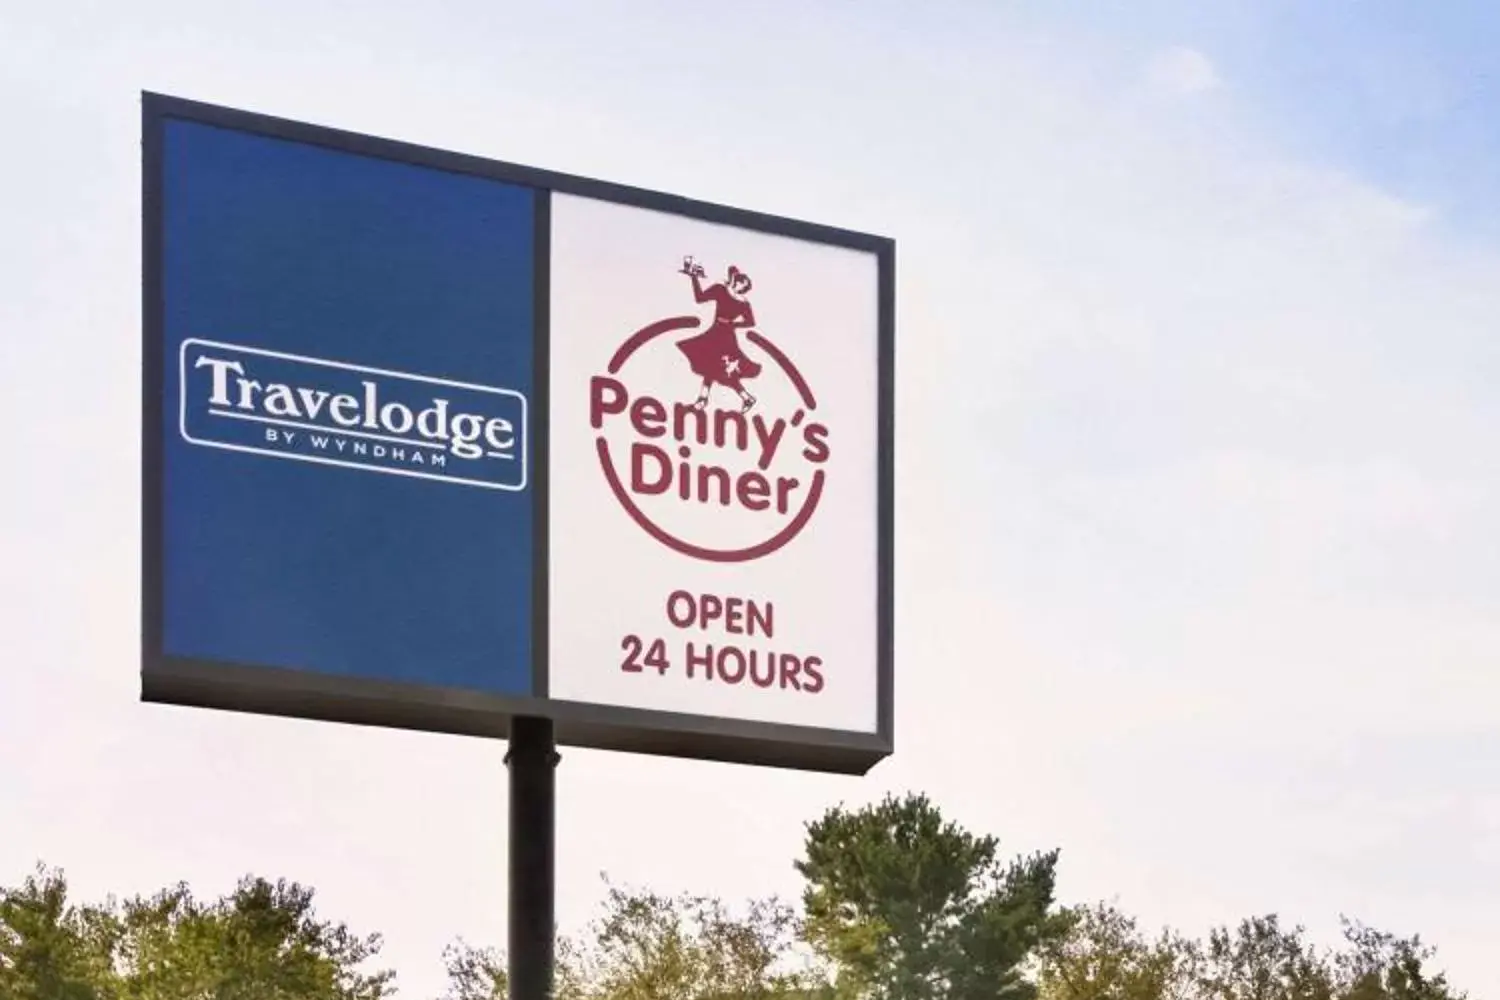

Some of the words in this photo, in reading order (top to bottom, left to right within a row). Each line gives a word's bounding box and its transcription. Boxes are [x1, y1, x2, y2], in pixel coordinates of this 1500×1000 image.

[194, 355, 515, 460] Travelodge
[590, 375, 830, 470] Penny's
[264, 428, 296, 445] BY
[311, 435, 447, 467] WYNDHAM
[631, 441, 799, 515] Diner
[666, 589, 774, 639] OPEN
[621, 634, 670, 676] 24
[686, 641, 825, 694] HOURS
